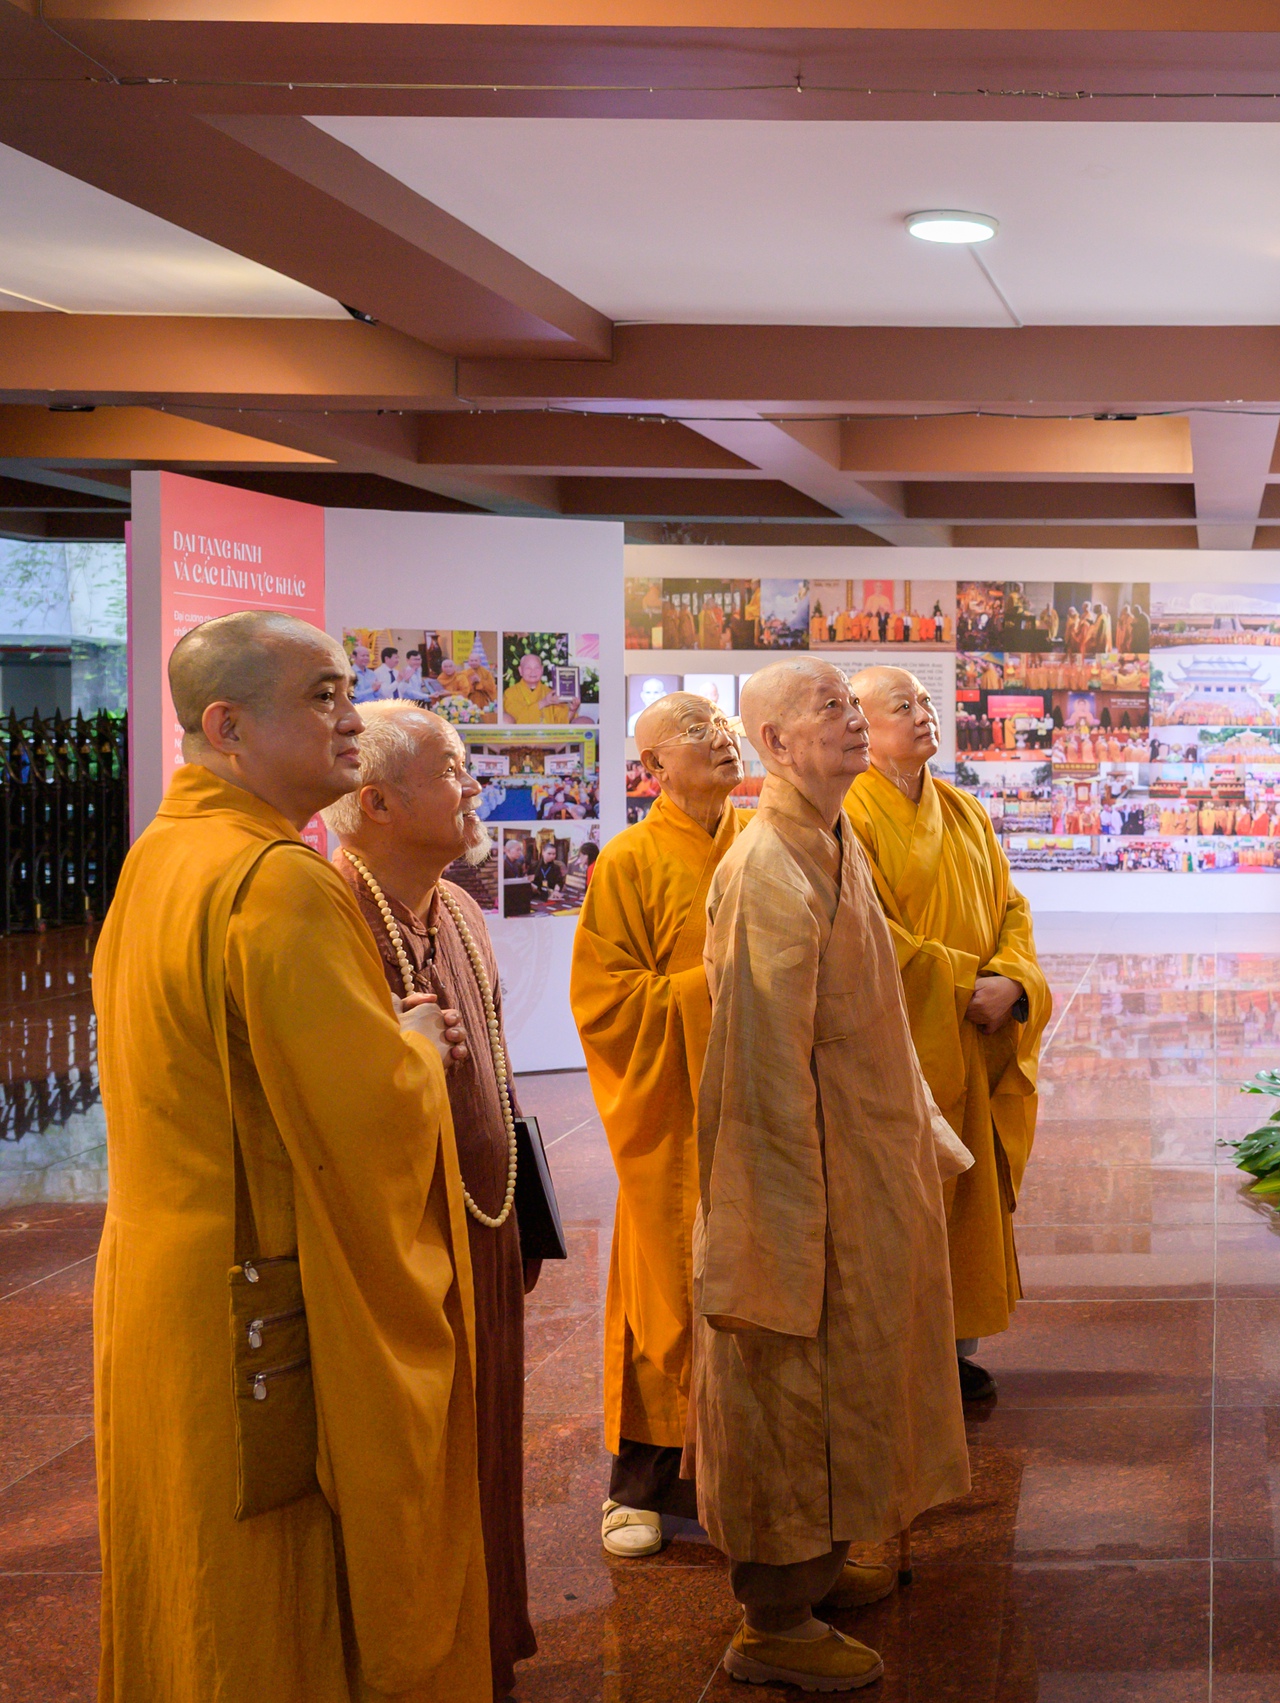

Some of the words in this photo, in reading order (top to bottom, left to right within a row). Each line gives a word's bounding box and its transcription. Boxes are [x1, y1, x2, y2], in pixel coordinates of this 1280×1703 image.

[174, 530, 196, 556] ĐẠI
[198, 535, 231, 560] TẠNG
[234, 541, 262, 564] KINH
[174, 556, 190, 581] VÀ
[192, 556, 218, 586] CÁC
[221, 565, 248, 589] LĨNH
[250, 571, 274, 597] VỰC
[276, 574, 306, 597] KHÁC
